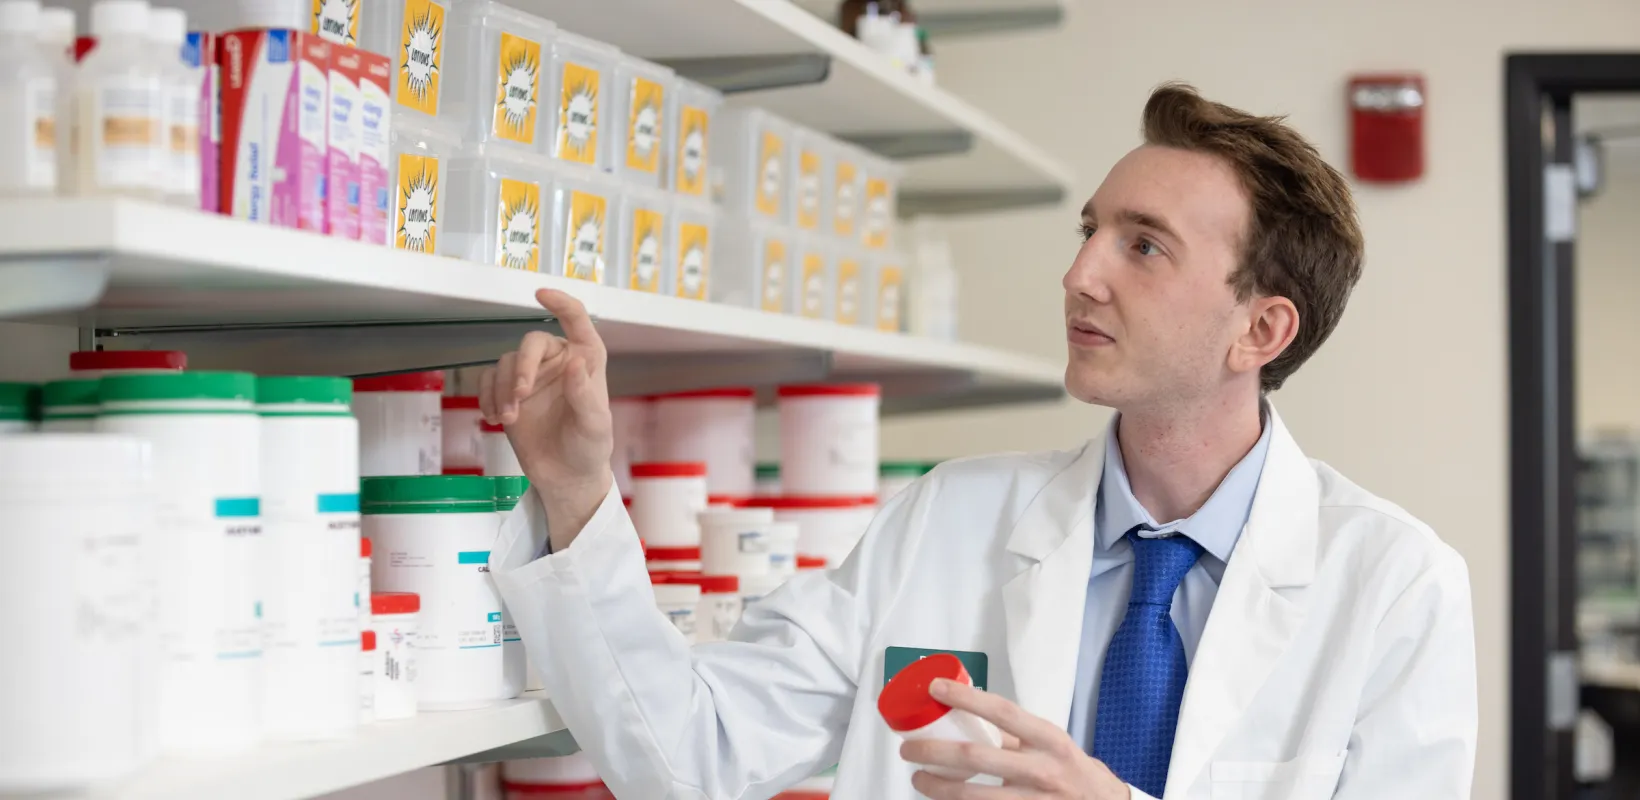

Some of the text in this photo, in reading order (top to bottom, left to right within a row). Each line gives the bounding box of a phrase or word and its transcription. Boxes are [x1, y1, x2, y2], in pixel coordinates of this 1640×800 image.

[322, 17, 345, 37] LOTIONS
[411, 48, 430, 67] LOTIONS
[508, 85, 529, 101] LOTIONS
[408, 208, 428, 223] LOTIONS
[509, 230, 530, 244] LOTIONS
